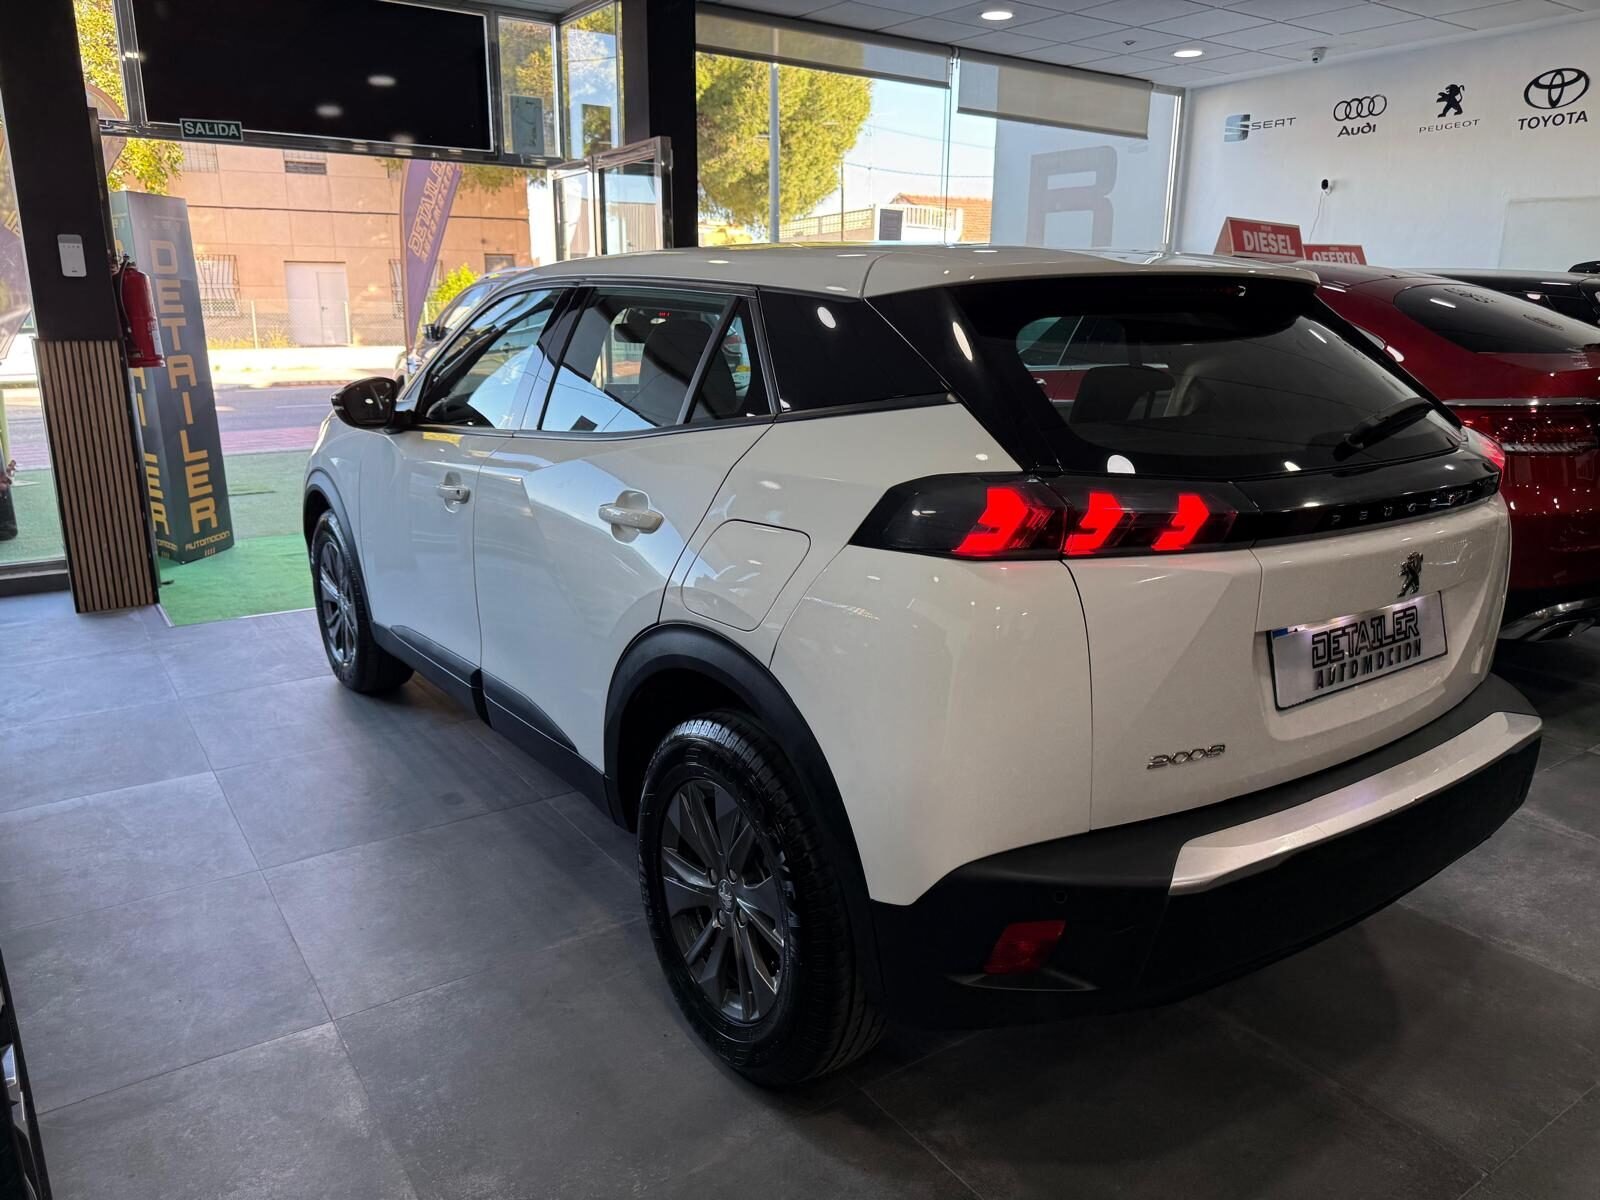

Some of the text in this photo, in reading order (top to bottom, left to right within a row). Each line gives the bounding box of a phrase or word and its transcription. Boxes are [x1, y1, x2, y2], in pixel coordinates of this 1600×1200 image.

[183, 121, 240, 137] SALIDA
[1251, 117, 1297, 130] SEAT
[1337, 122, 1377, 138] Audi
[1418, 118, 1481, 134] PEUGEOT
[1517, 110, 1588, 131] TOYOTA
[408, 160, 447, 257] DETAILE
[1242, 230, 1296, 255] DIESEL
[1312, 251, 1360, 265] OFERTA
[149, 238, 218, 535] DETAILER
[1312, 605, 1420, 669] DETAILER
[1313, 637, 1422, 690] AUTOMOCION
[1146, 744, 1226, 769] 2008
